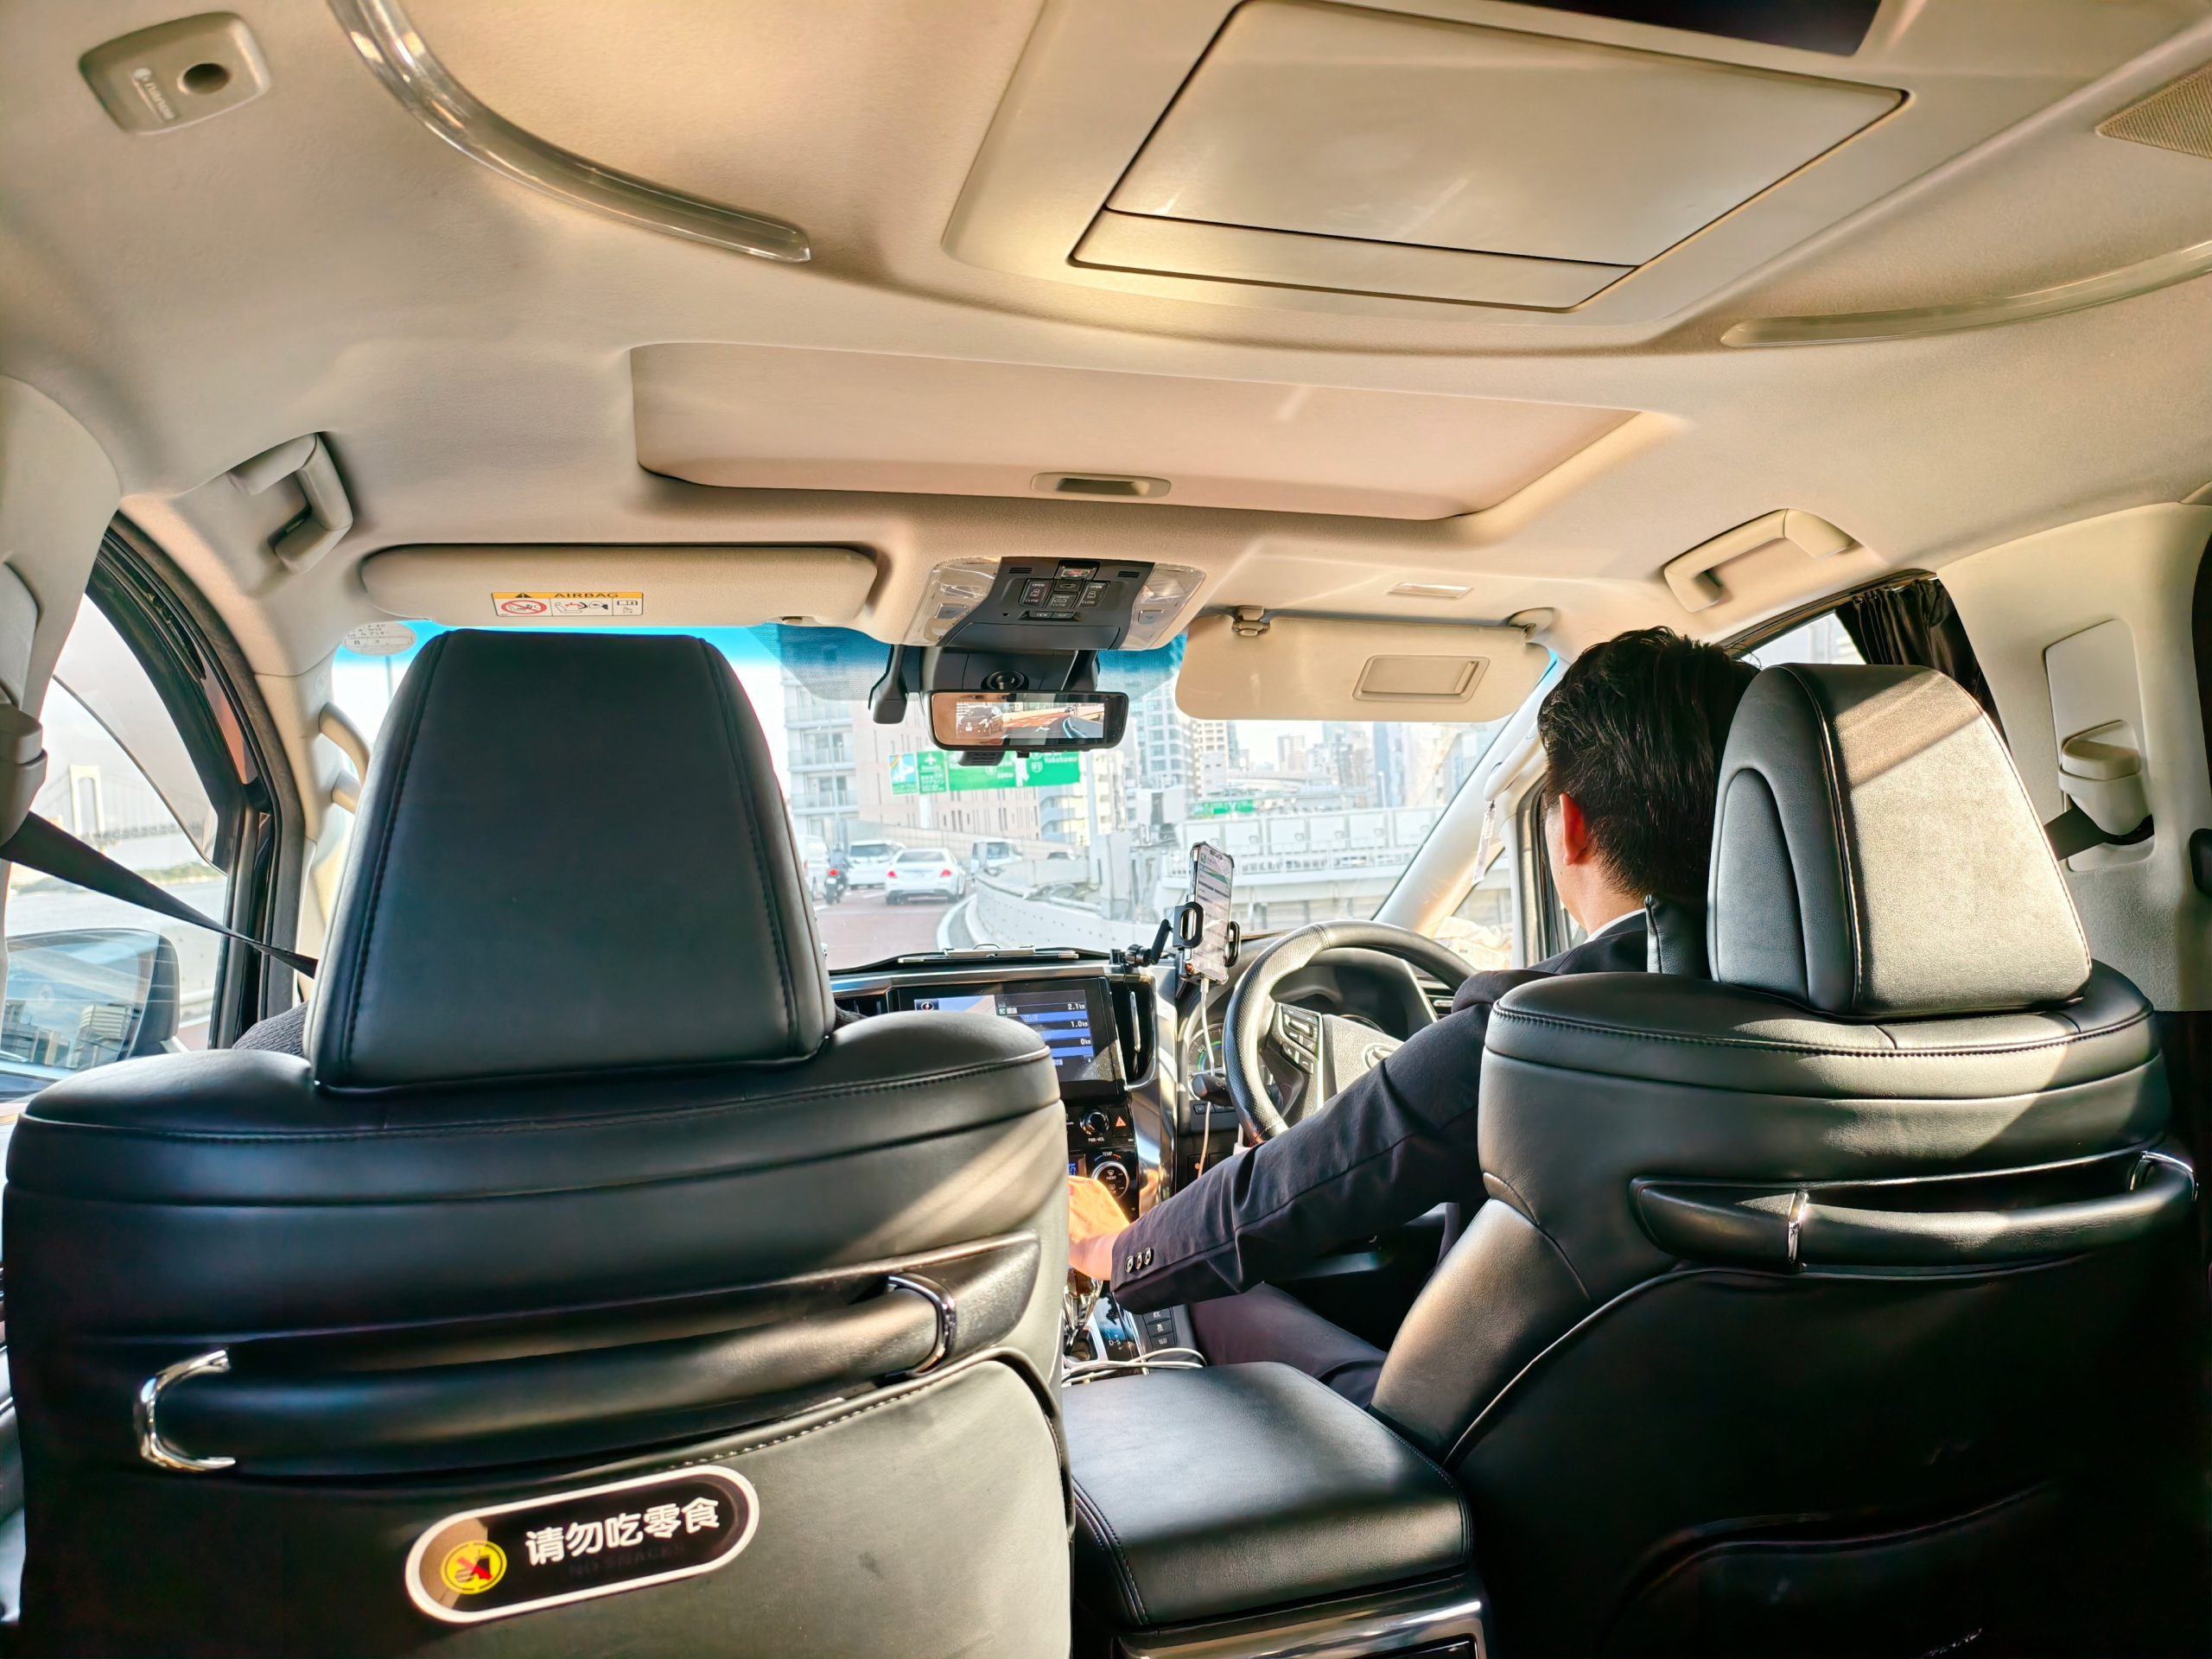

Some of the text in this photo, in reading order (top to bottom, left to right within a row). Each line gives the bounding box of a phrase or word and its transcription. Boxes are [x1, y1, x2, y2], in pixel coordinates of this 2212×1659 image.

[524, 1497, 721, 1567] 请勿吃零食
